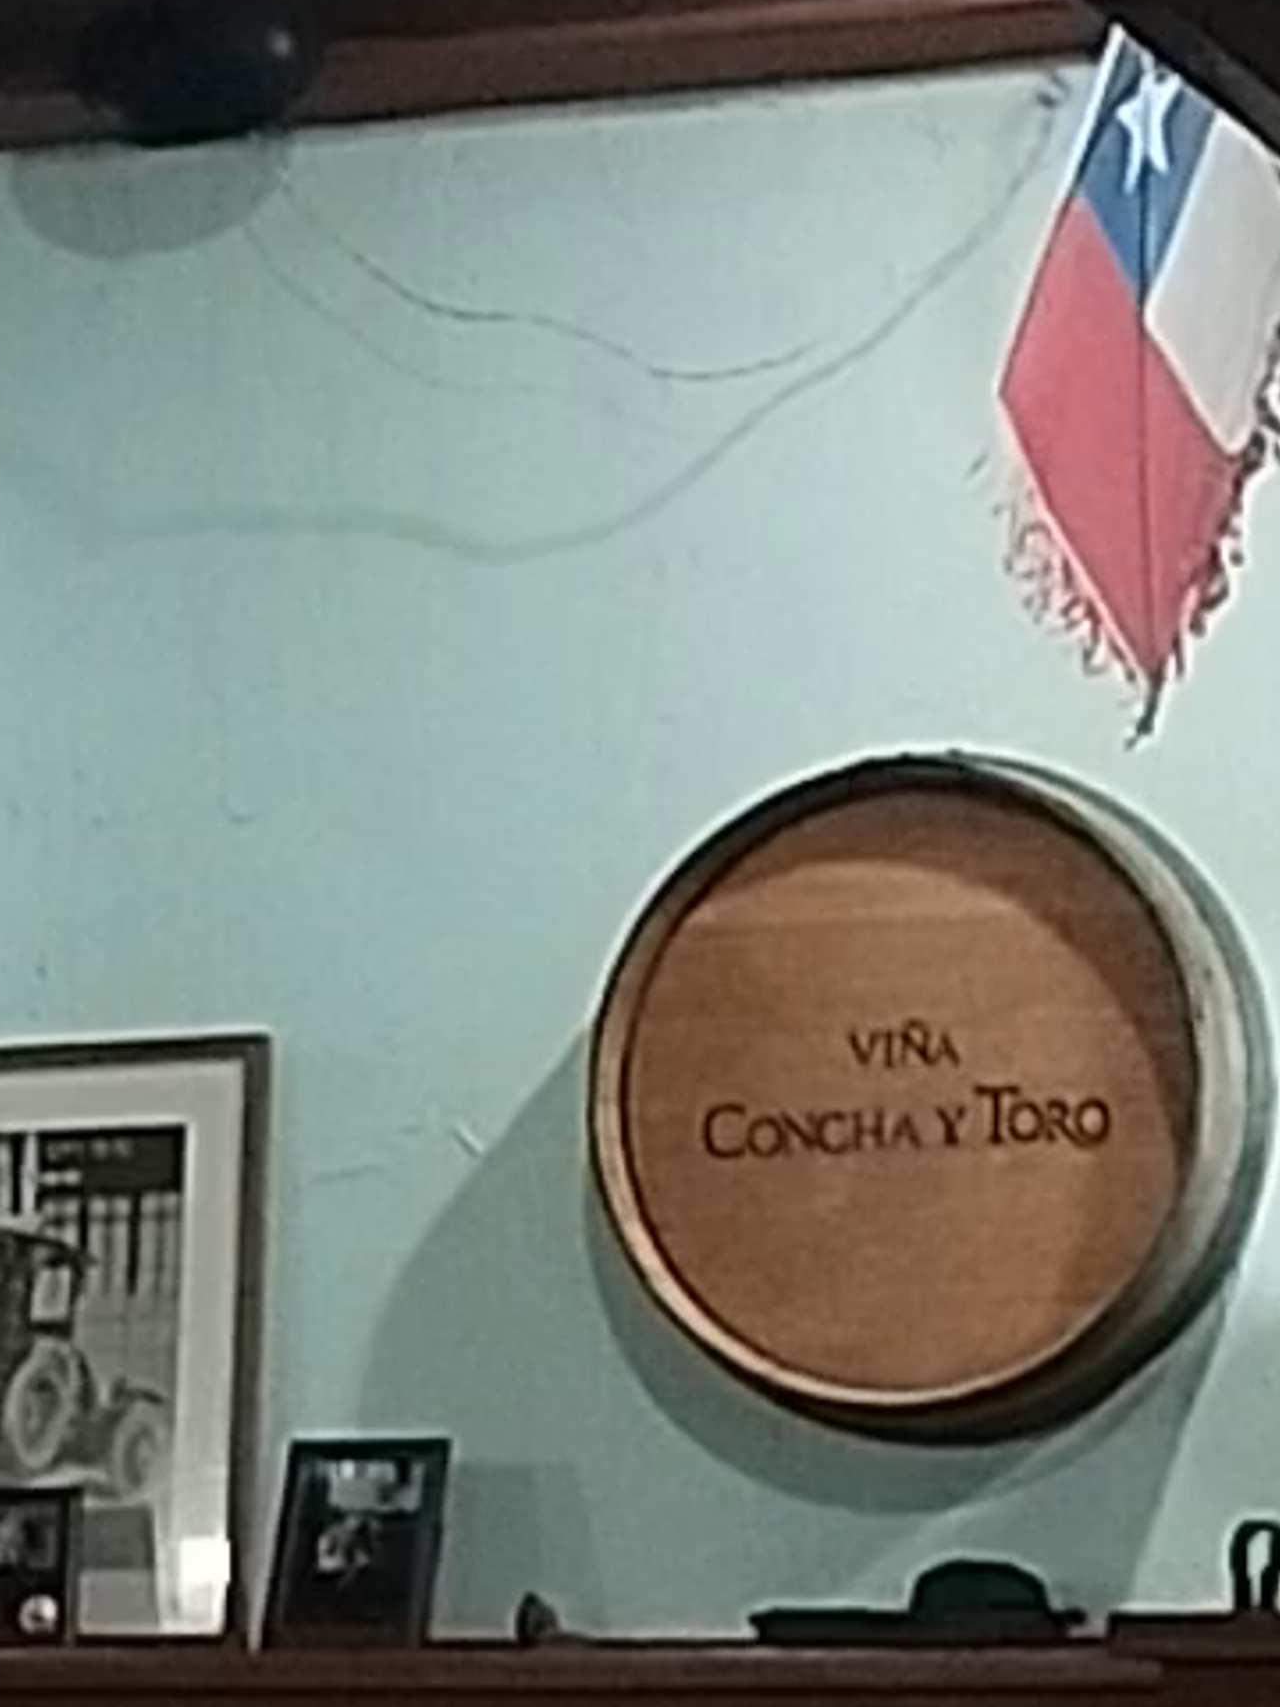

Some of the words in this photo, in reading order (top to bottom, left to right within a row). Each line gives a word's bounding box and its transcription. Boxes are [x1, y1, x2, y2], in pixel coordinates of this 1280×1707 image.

[846, 1018, 961, 1071] VIÑA
[701, 1102, 921, 1160] CONCHA
[935, 1106, 966, 1148] Y
[973, 1084, 1112, 1152] TORO
